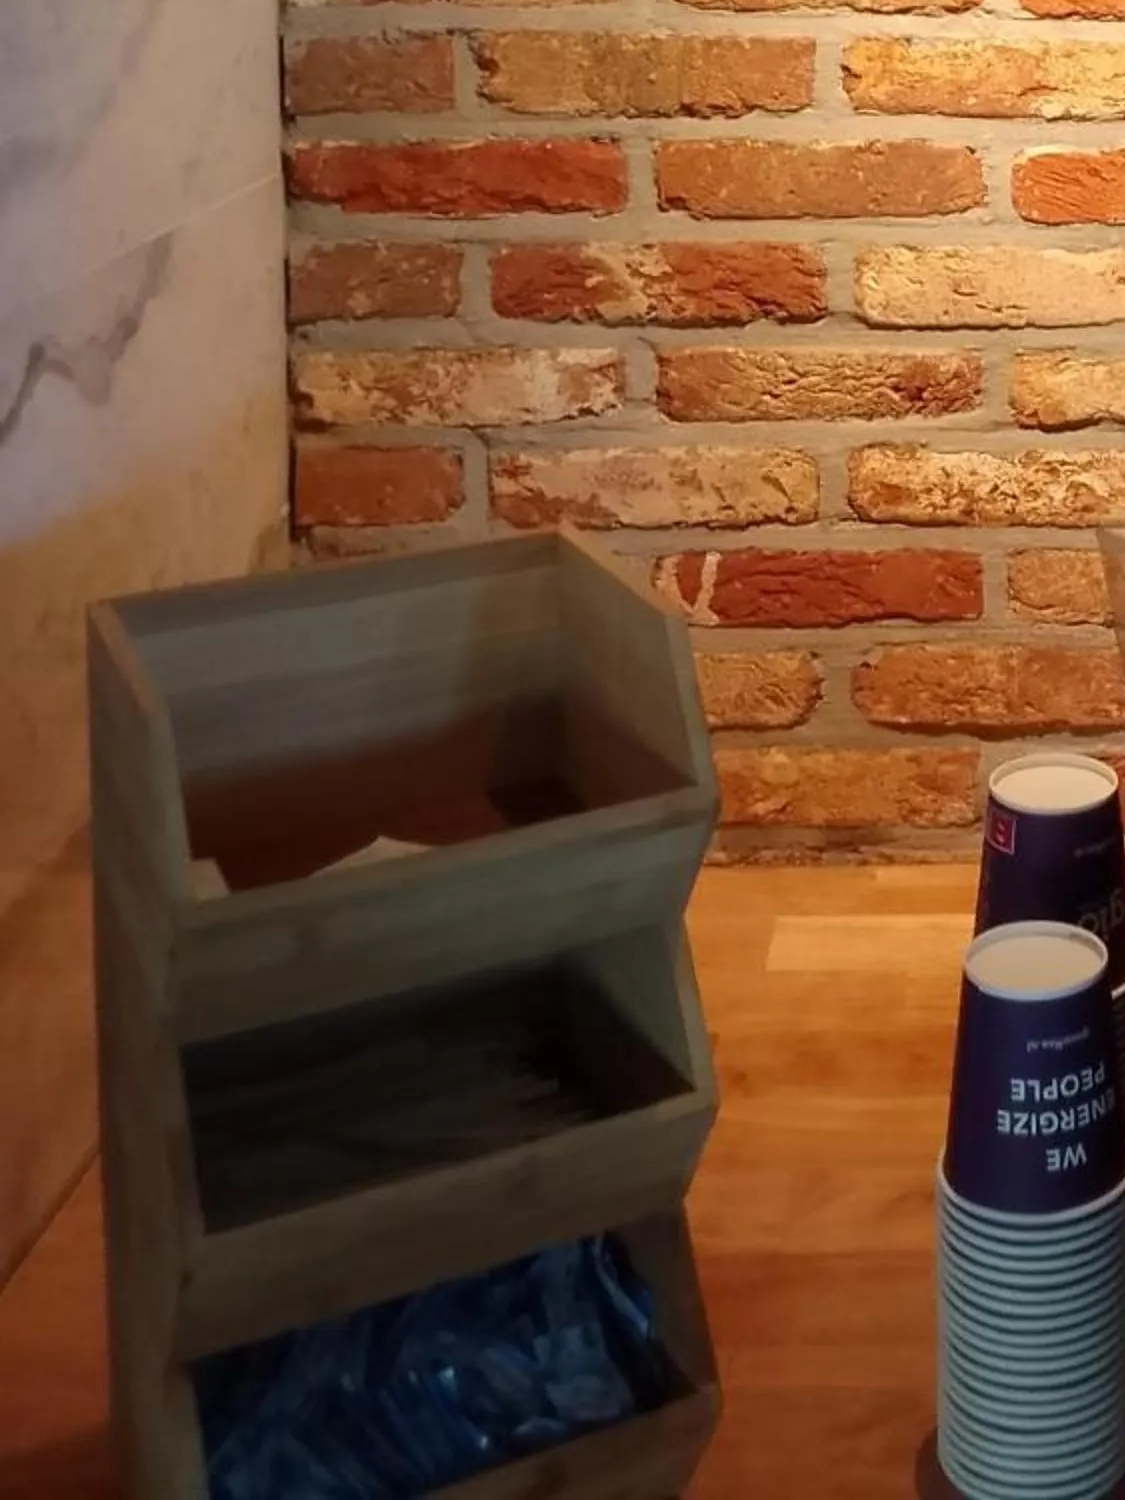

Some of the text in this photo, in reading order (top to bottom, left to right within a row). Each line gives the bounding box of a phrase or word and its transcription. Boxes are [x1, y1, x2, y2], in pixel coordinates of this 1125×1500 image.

[1009, 1060, 1106, 1102] PEOPLE
[996, 1087, 1116, 1137] ENERGIZE
[1045, 1141, 1088, 1173] WE
